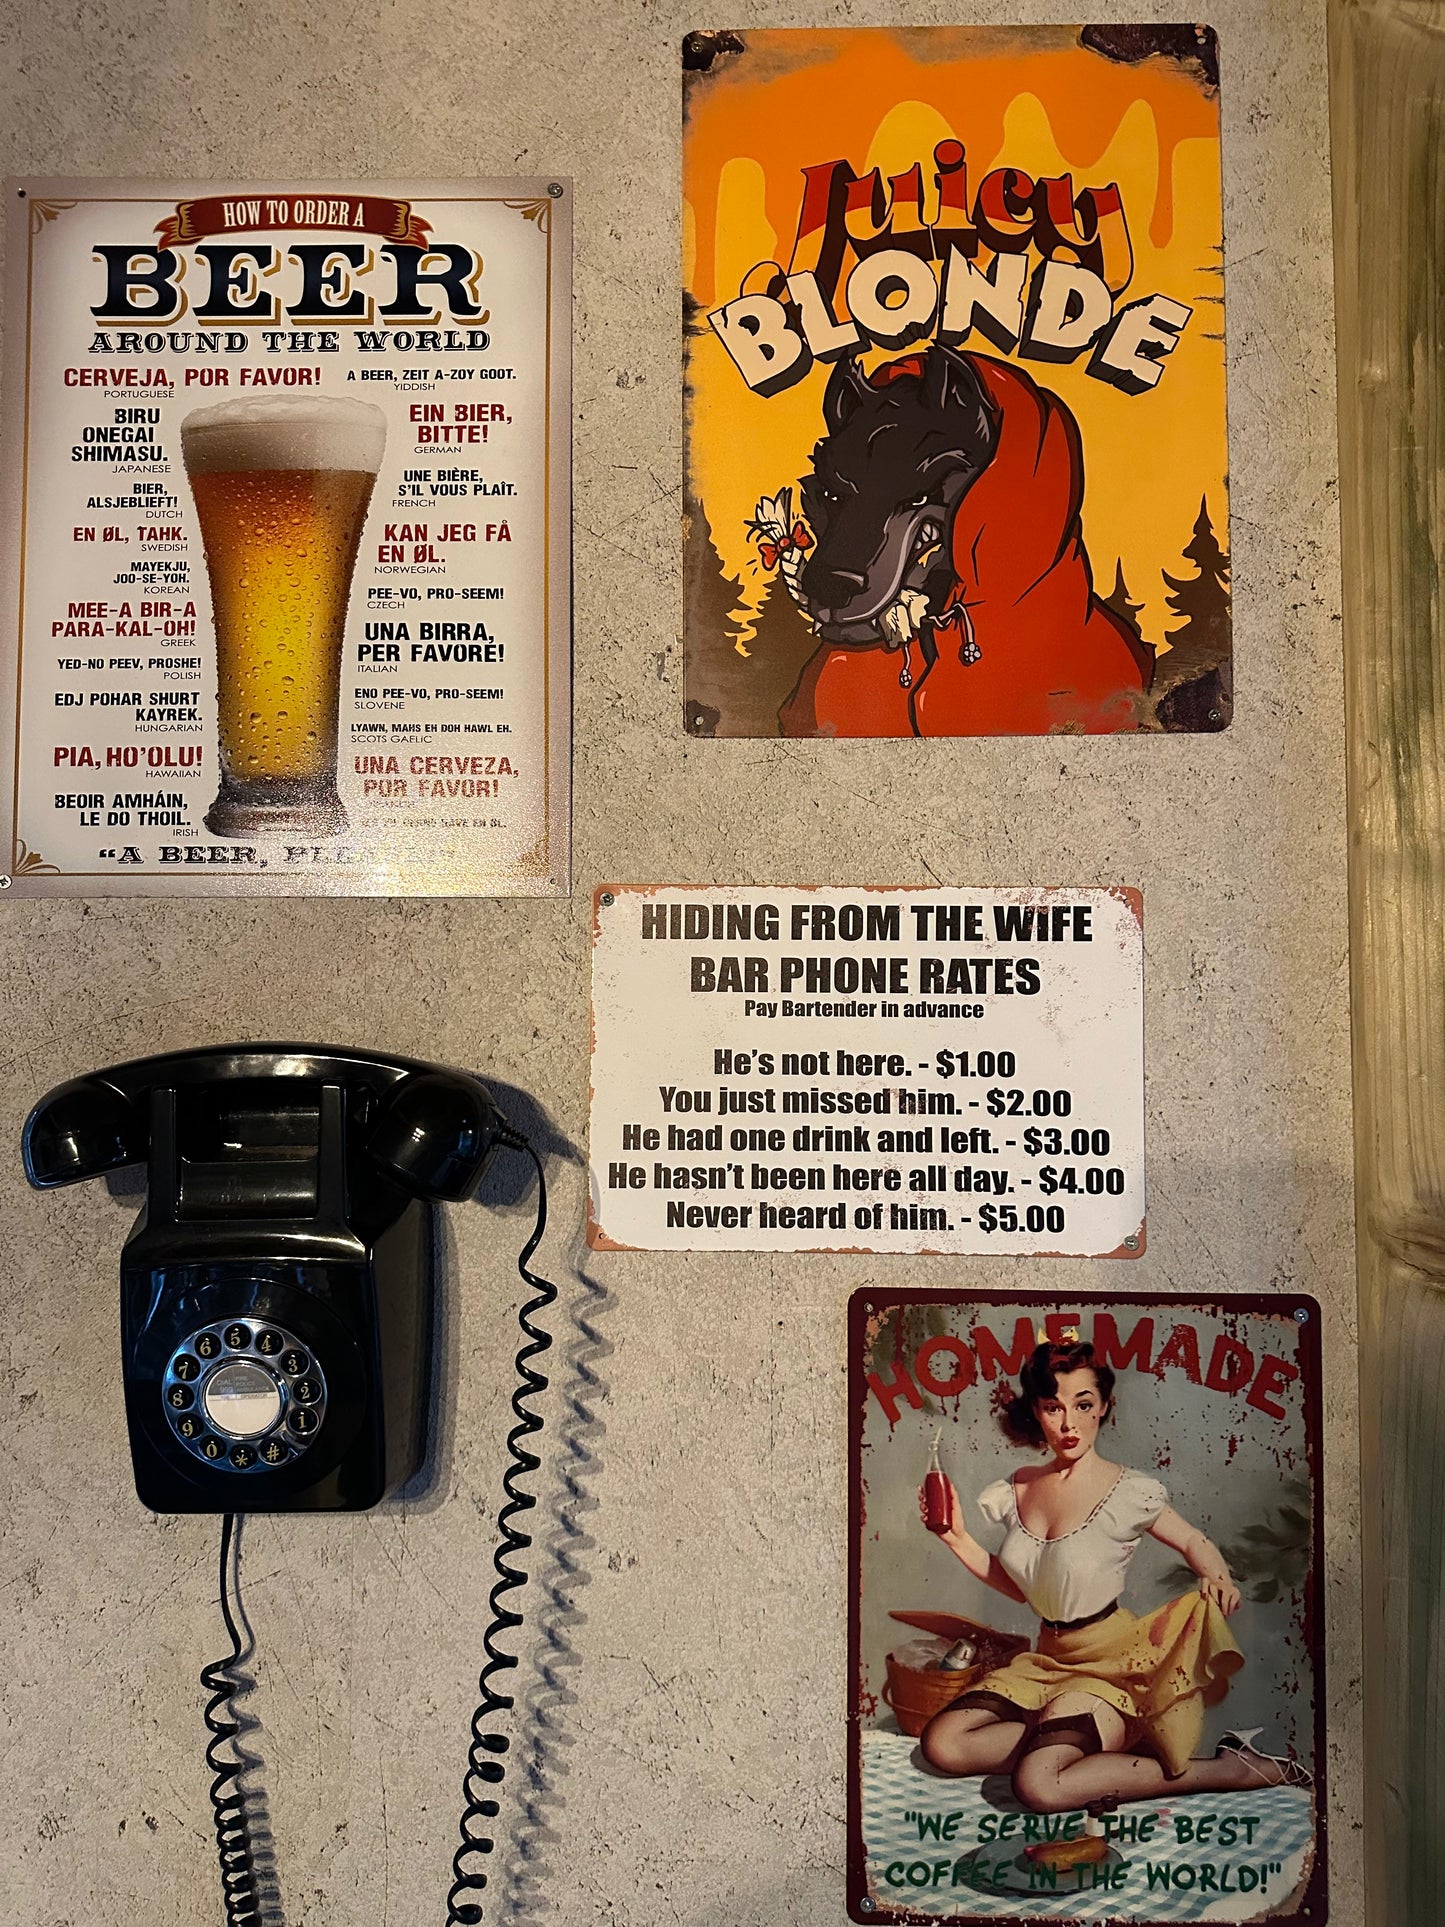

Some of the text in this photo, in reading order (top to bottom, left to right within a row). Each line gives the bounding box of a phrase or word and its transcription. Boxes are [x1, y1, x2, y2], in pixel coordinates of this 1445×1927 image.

[222, 200, 365, 227] HOW TO ORDER A
[90, 244, 491, 326] BEER
[707, 243, 1194, 398] BLONDE
[88, 330, 491, 354] AROUND THE WORLD
[64, 367, 321, 389] CERVEJA, POR FAVOR!
[347, 369, 516, 382] A BEER, ZEIT A-ZOY GOOT.
[115, 408, 160, 423] BIRU
[410, 404, 512, 424] EIN BIER,
[82, 427, 153, 442] ONEGAI
[418, 425, 488, 443] BITTE!
[72, 446, 168, 462] SHIMASU.
[404, 468, 483, 483] UNE BIÈRE,
[133, 484, 168, 496] BIER,
[430, 484, 467, 495] VOUS
[474, 482, 518, 495] PLAÎT.
[87, 497, 178, 508] ALSJEBLIEFT!
[74, 527, 95, 541] EN
[103, 526, 129, 543] ØL,
[385, 520, 512, 542] KAN JEG FÅ
[378, 544, 445, 563] EN ØL.
[131, 562, 190, 573] MAYEKJU,
[113, 574, 189, 583] JOO-SE-YOH.
[368, 588, 503, 601] PEE-VO, PRO-SEEM!
[68, 602, 197, 618] MEE-A BIR-A
[52, 621, 196, 637] PARA-KAL-OH!
[365, 623, 494, 644] UNA BIRRA,
[161, 639, 196, 647] GREEK
[358, 644, 504, 662] PER FAVORE!
[58, 658, 201, 670] YED-NO PEEV, PROSHE!
[55, 692, 200, 706] EDJ POHAR SHURT
[355, 689, 503, 700] ENO PEE-VO, PRO-SEEM!
[354, 702, 405, 710] SLOVENE
[136, 708, 202, 721] KAYREK.
[135, 724, 203, 732] HUNGARIAN
[351, 724, 512, 734] LYAWN, MAHS EH DOH HAWL EH.
[351, 735, 432, 743] SCOTS GAELIC
[54, 747, 101, 770] PIA,
[146, 770, 201, 778] HAWAIIAN
[355, 756, 519, 778] UNA CERVEZA,
[364, 779, 499, 798] POR FAVOR!
[55, 790, 188, 810] BEOIR AMHÁIN,
[80, 812, 191, 826] LE DO THOIL.
[158, 846, 268, 868] BEER,
[642, 904, 1092, 942] HIDING FROM THE WIFE
[691, 957, 1041, 995] BAR PHONE RATES
[744, 1000, 984, 1018] Pay Bartender in advance
[714, 1049, 1016, 1079] He’s not here. $1.00
[659, 1086, 1071, 1117] You just missed him. $2.00
[623, 1124, 1110, 1156] He had one drink and left. $3.00
[609, 1163, 1125, 1195] He hasn’t been here all day. $4.00
[667, 1201, 1065, 1233] Never heard of him. $5.00
[230, 1332, 241, 1346] 5
[261, 1338, 272, 1352] 4
[200, 1341, 211, 1356] 6
[866, 1313, 1299, 1421] HOMEMADE
[173, 1393, 183, 1407] 8
[904, 1811, 1261, 1846] "WE SERVE THE BEST
[885, 1860, 1281, 1893] COFFEE IN THE WORLD!"
